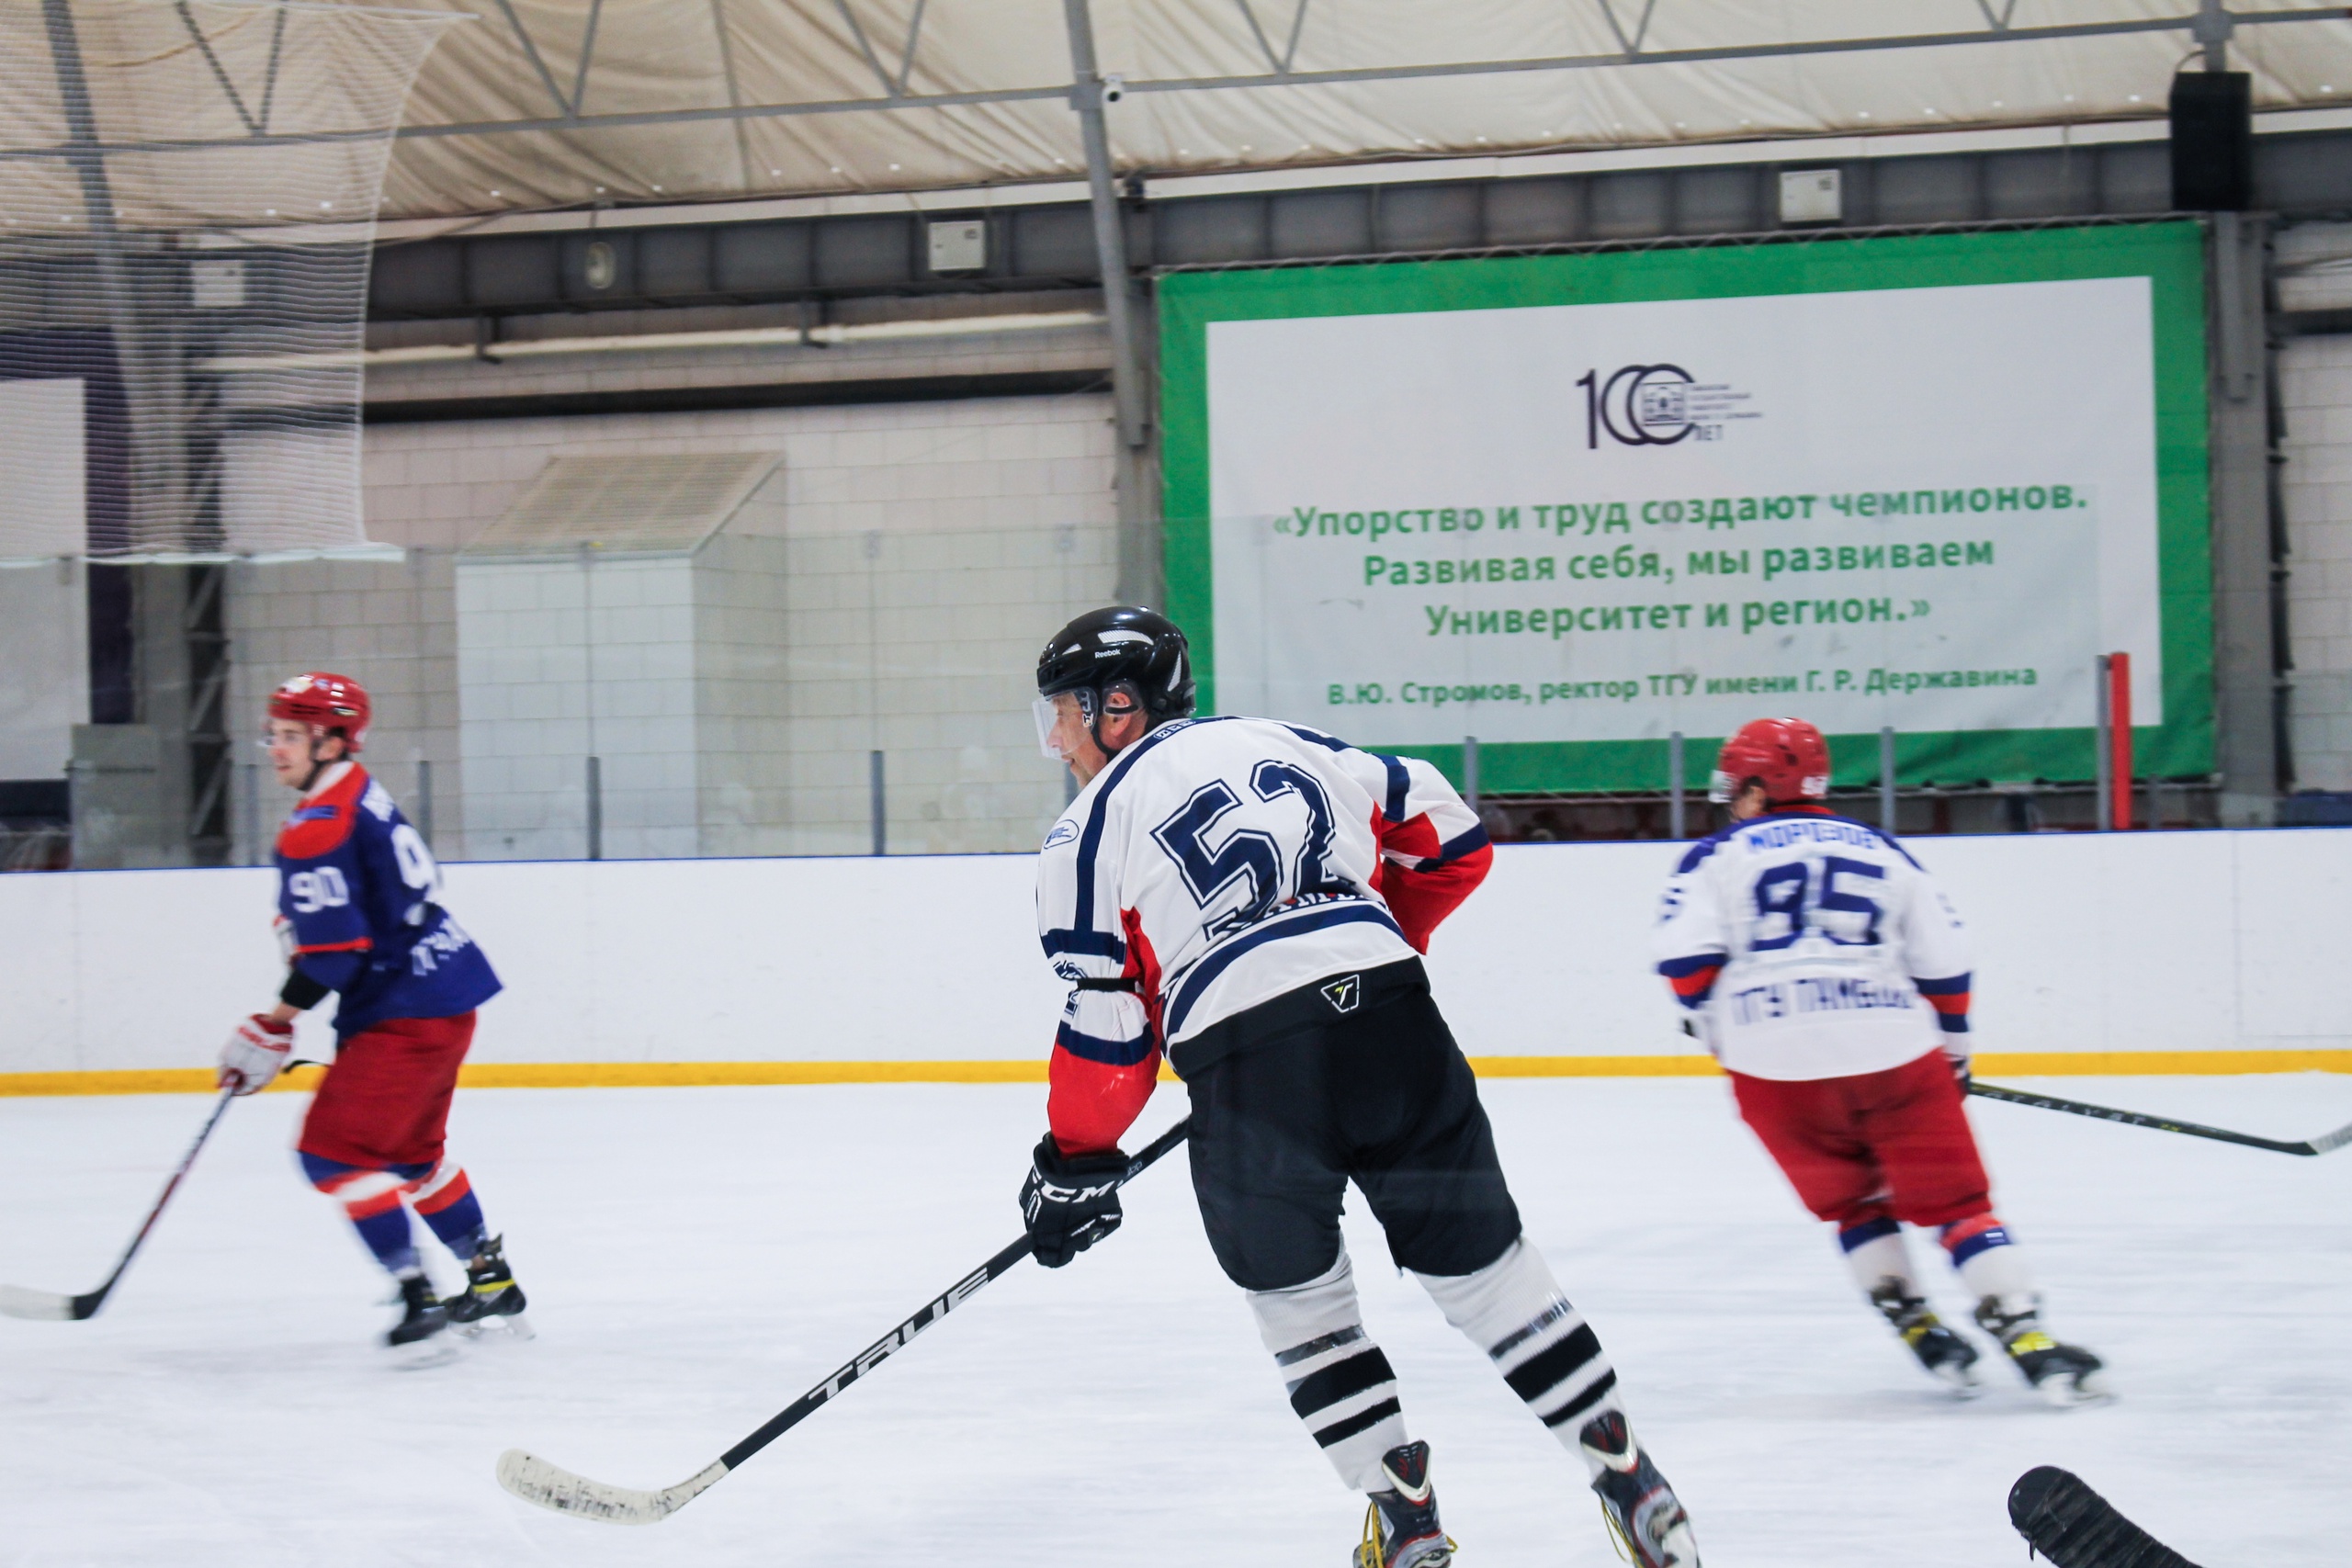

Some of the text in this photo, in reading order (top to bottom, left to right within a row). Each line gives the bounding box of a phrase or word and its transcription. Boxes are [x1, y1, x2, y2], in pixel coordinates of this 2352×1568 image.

[1273, 484, 2087, 542] «Упорство и труд создают чемпионов.
[1363, 540, 1995, 586] Развивая себя, мы развиваем
[1424, 596, 1931, 640] Университет и регион.»
[1094, 649, 1121, 659] Reebok
[1328, 667, 2039, 706] В.Ю. Стромов, ректор ТГУ имени Г. Р. Державина
[1151, 759, 1355, 942] 52
[288, 866, 350, 913] 90
[1751, 856, 1885, 952] 95
[808, 1267, 989, 1400] TRUE
